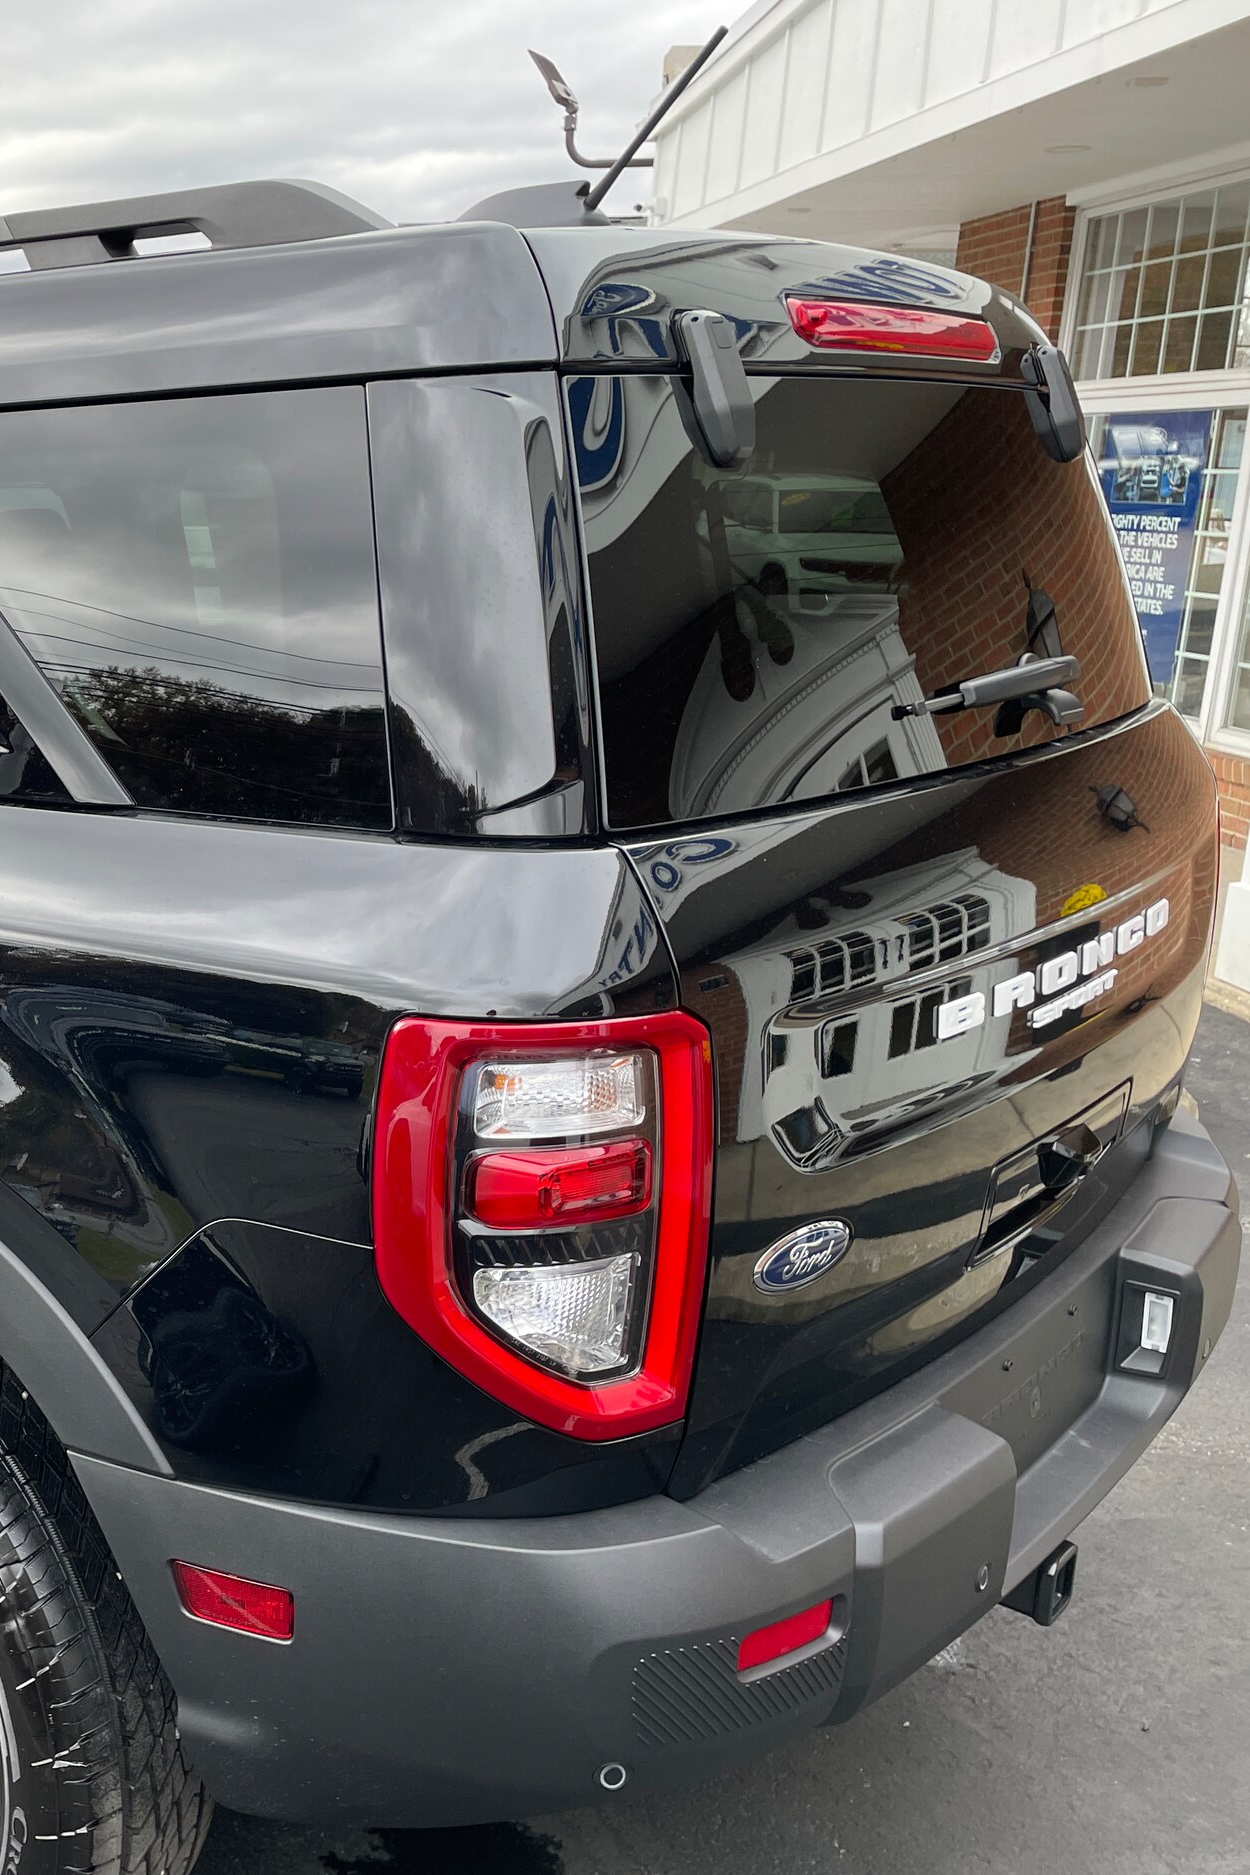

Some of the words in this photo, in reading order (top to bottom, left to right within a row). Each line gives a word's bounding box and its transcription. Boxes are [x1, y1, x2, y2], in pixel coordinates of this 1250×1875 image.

[1140, 515, 1181, 532] PERCENT
[1119, 531, 1136, 546] THE
[1137, 532, 1178, 549] VEHICLES
[1130, 548, 1150, 563] SELL
[1151, 550, 1162, 564] IN
[1126, 563, 1145, 579] RICA
[1145, 566, 1165, 581] ARE
[1144, 582, 1154, 597] IN
[1156, 583, 1174, 600] THE
[1134, 597, 1163, 615] TATES.
[933, 898, 1169, 1040] BRONCO
[1027, 968, 1118, 1029] SPORT
[782, 1237, 836, 1281] Ford
